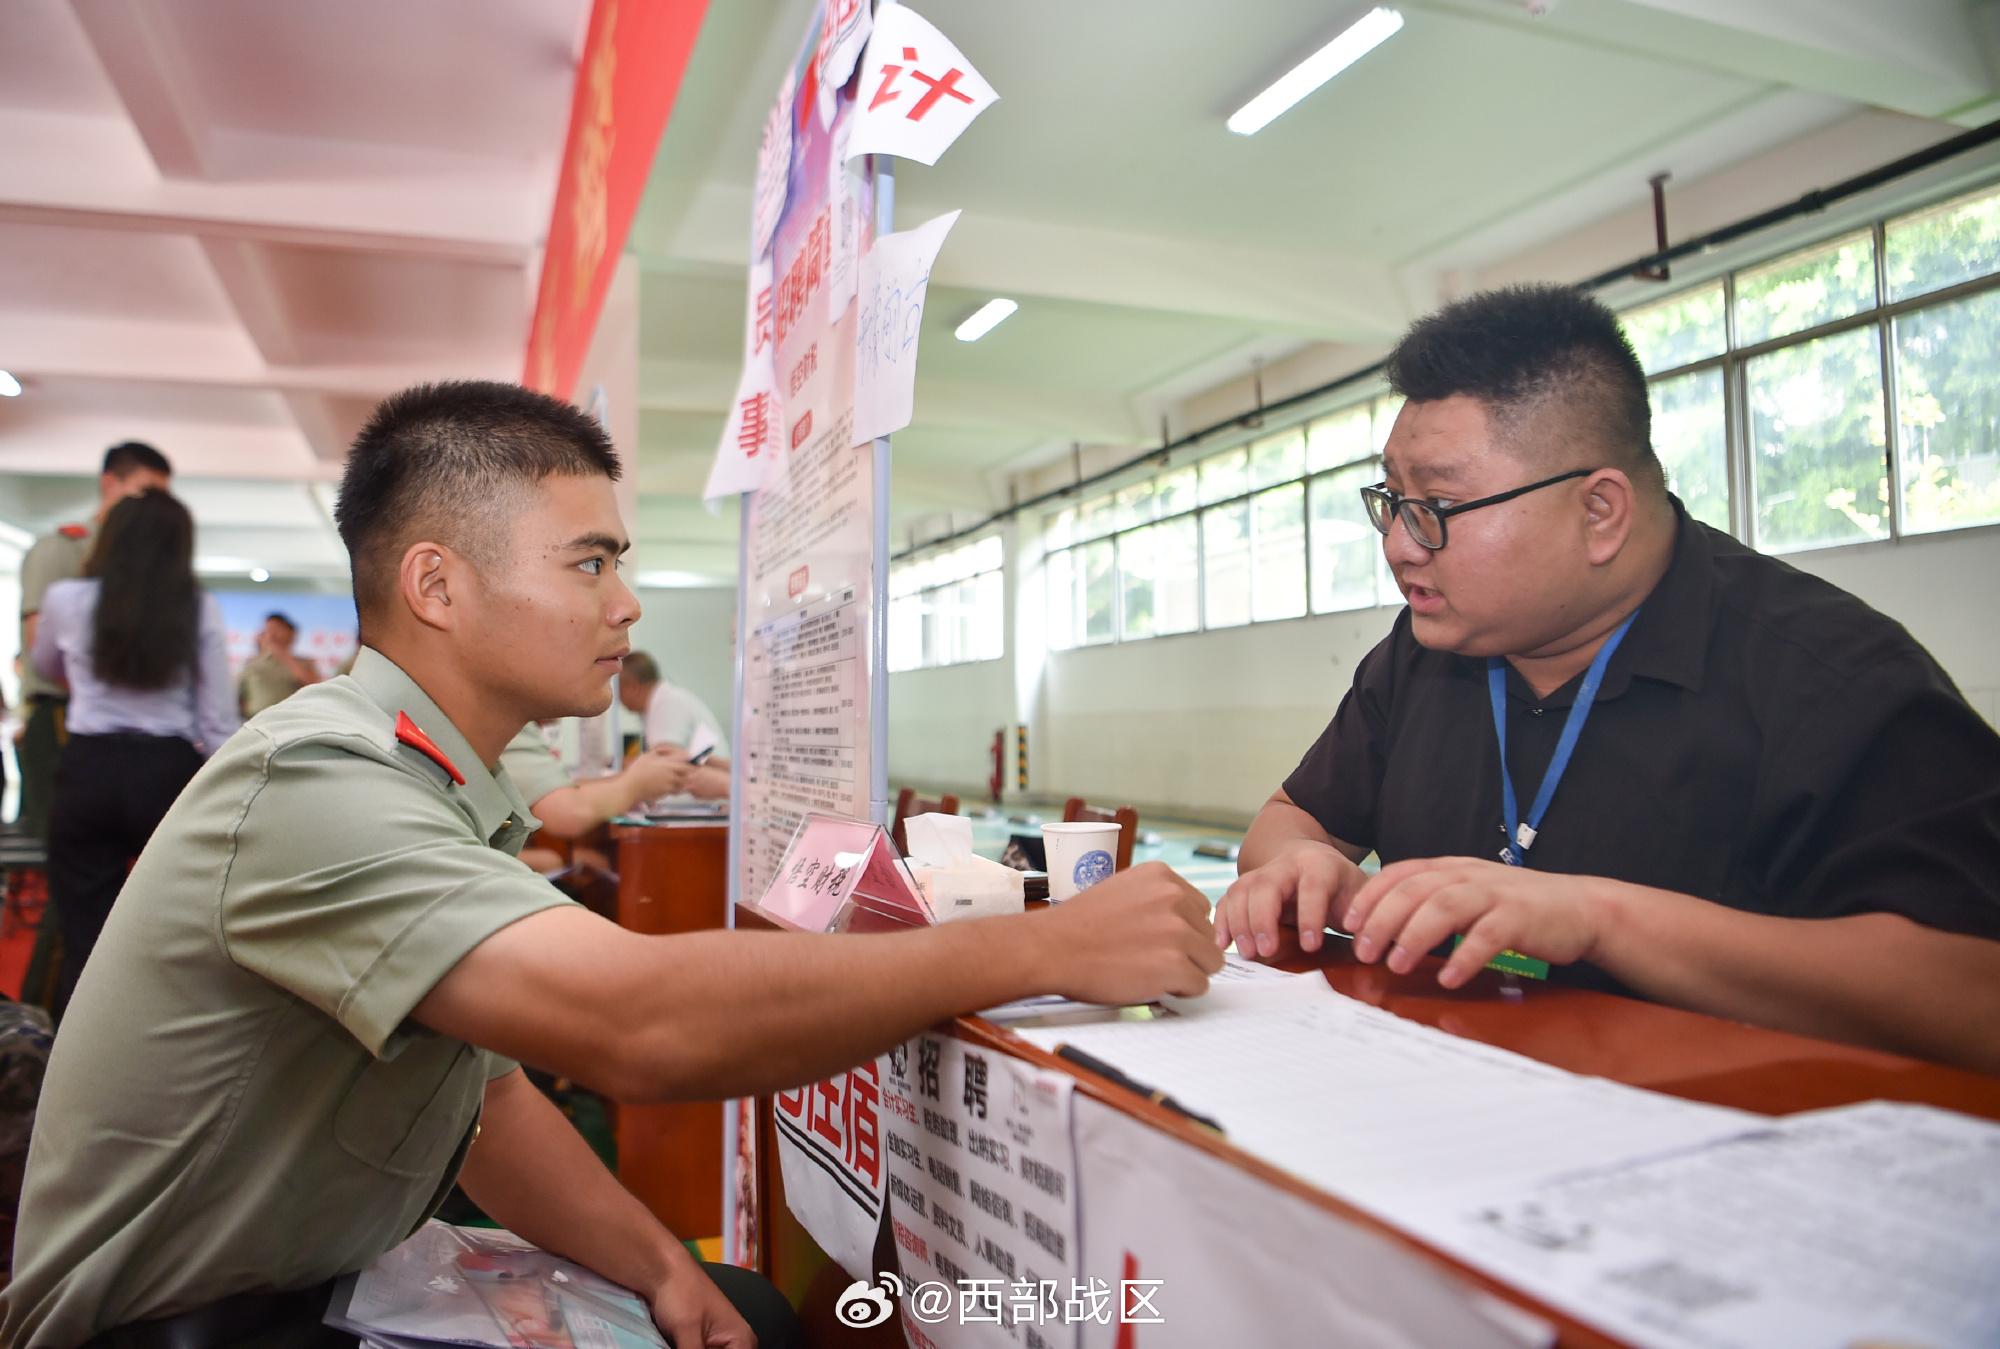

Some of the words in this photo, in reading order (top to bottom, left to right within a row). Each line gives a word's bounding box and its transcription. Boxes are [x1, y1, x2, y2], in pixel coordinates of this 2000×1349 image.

[868, 46, 975, 122] 计
[738, 391, 770, 459] 事
[918, 1036, 988, 1120] 招聘
